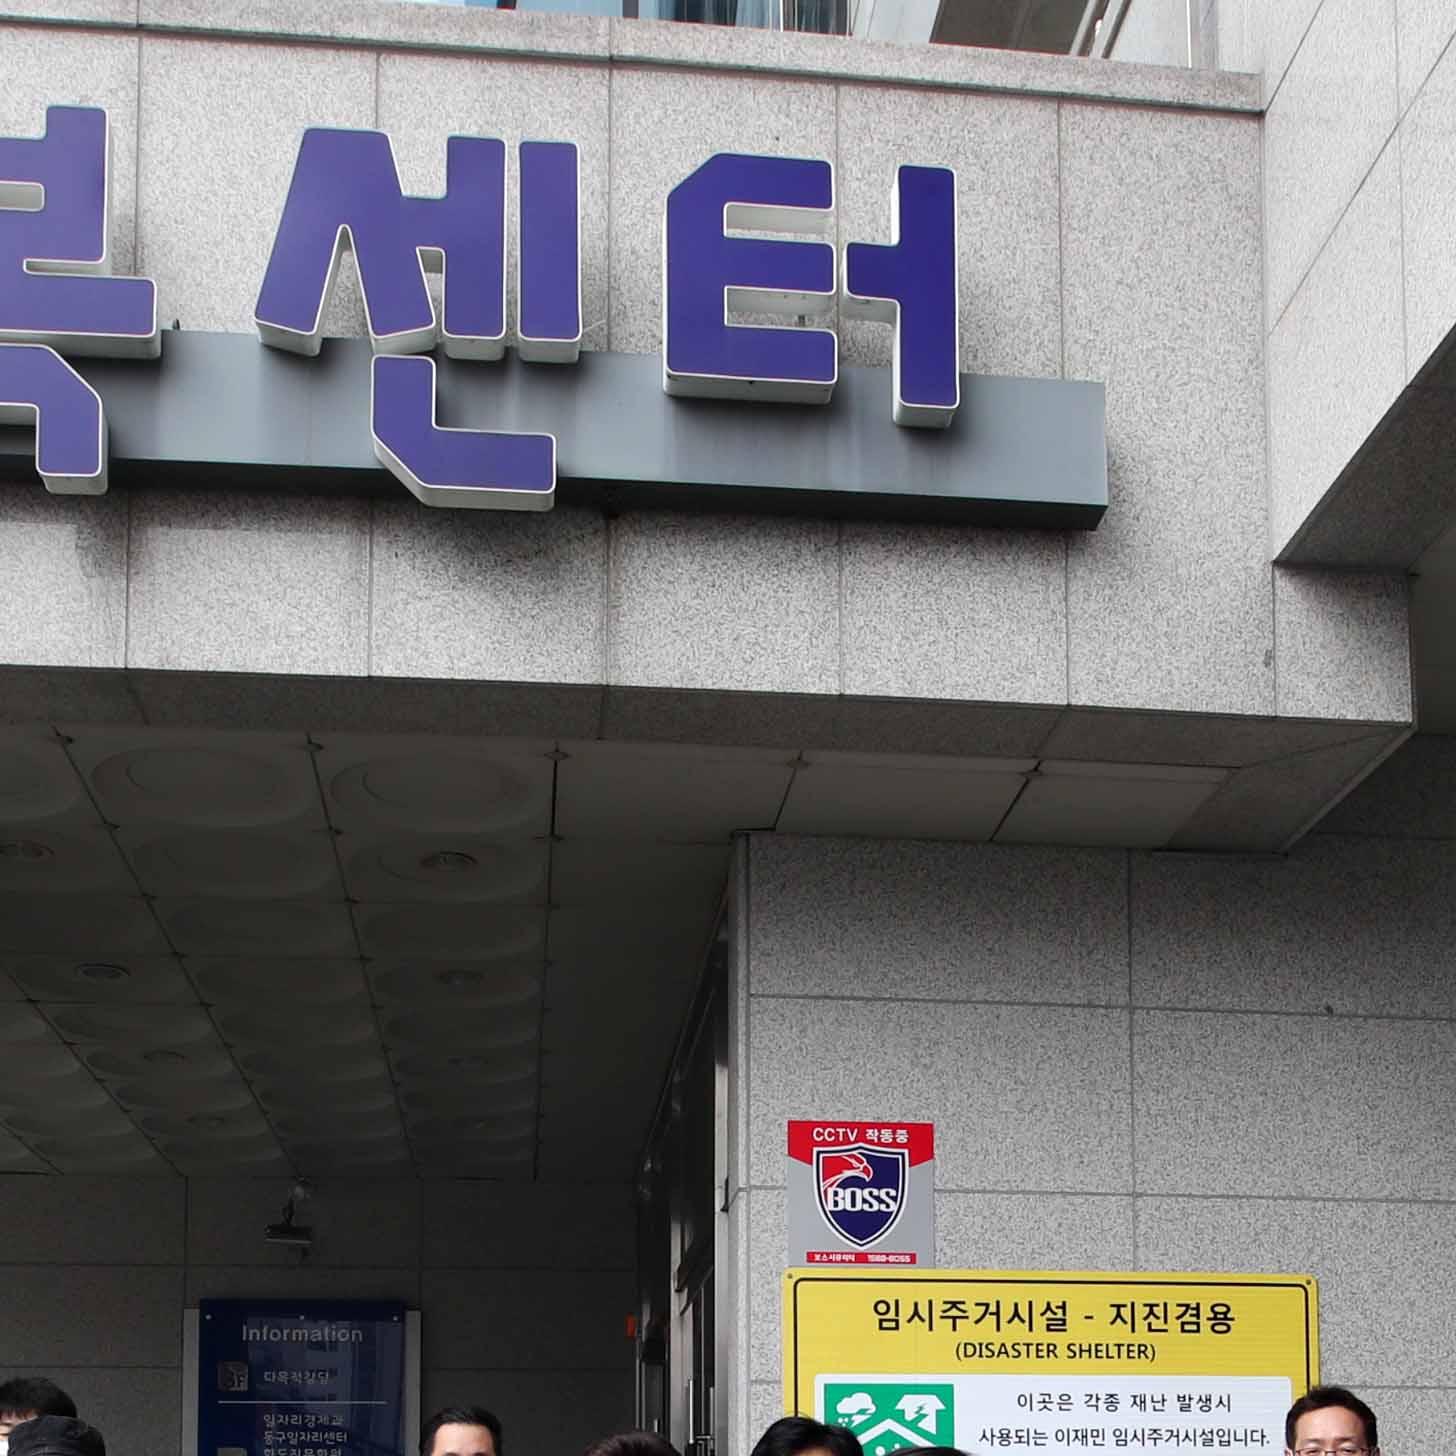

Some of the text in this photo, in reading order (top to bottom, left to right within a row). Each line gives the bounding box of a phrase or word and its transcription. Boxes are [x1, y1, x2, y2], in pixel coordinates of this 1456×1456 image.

[813, 1127, 909, 1143] CCTV 작동중
[826, 1187, 897, 1212] BOSS
[872, 1299, 1068, 1333] 임시주거시설
[1109, 1301, 1236, 1336] 지진겸용
[242, 1324, 364, 1343] Information
[955, 1341, 1156, 1363] (DISASTER SHELTER)
[1017, 1393, 1232, 1413] 이곳은 각종 재난 발생시
[979, 1428, 1271, 1448] 사용되는 이재민 임시주거시설입니다.
